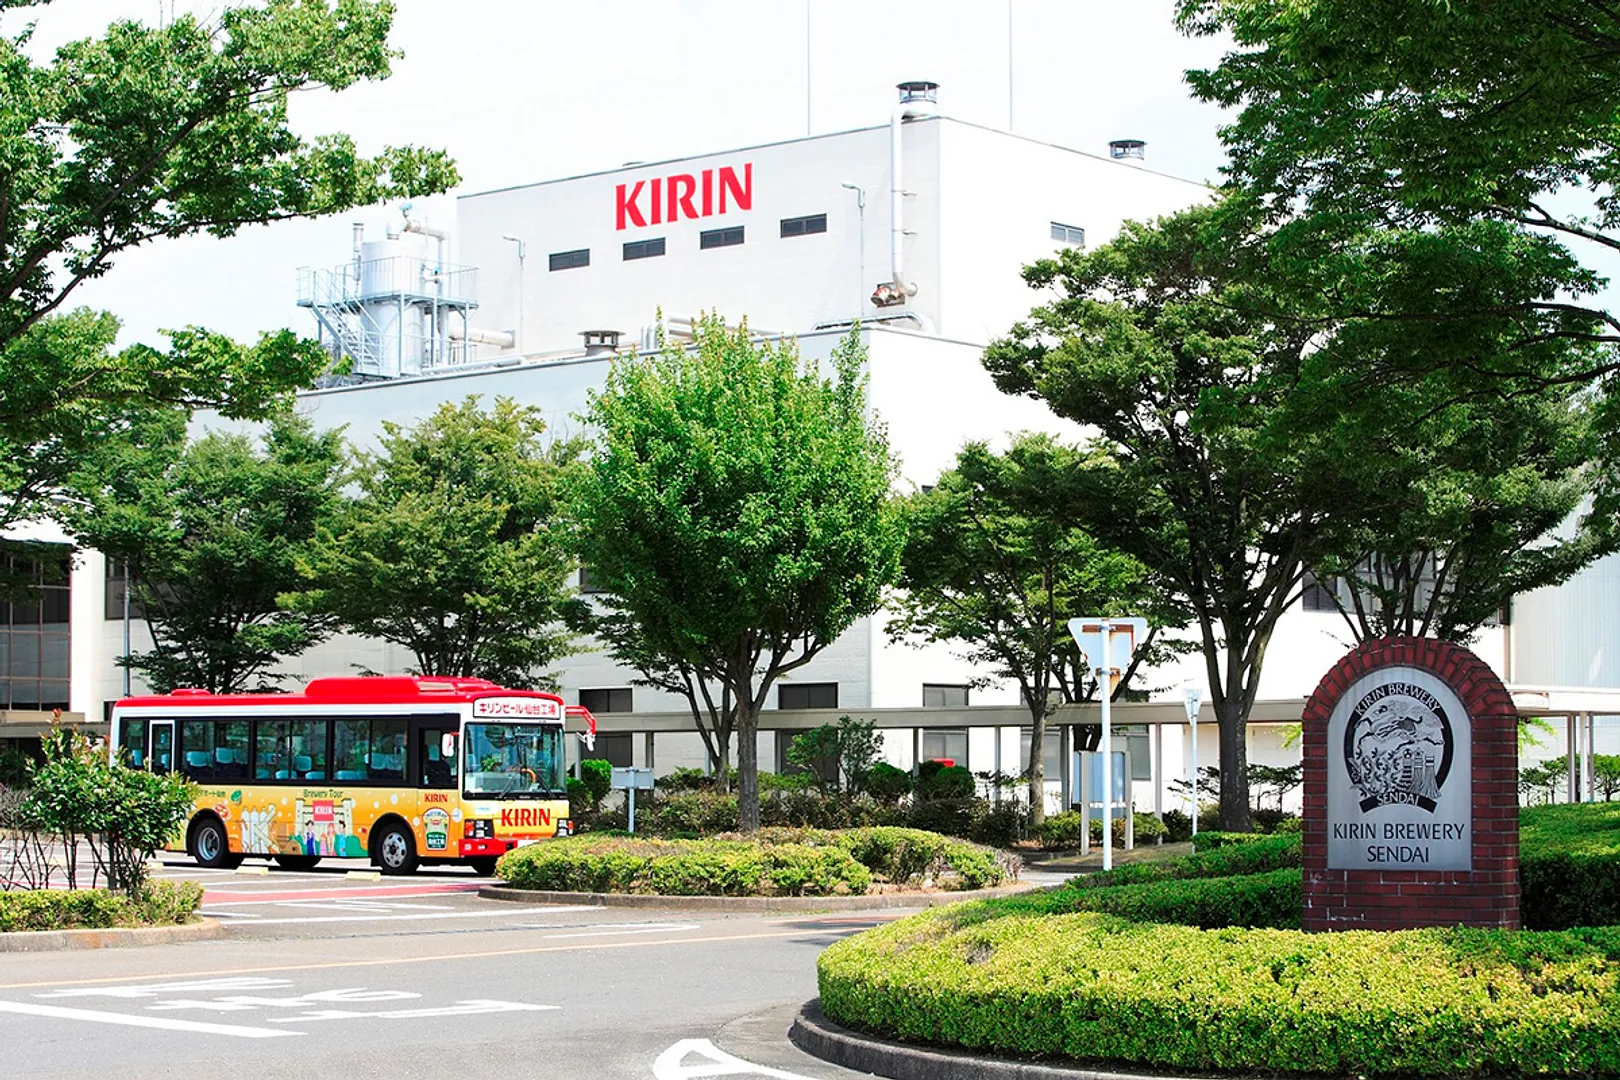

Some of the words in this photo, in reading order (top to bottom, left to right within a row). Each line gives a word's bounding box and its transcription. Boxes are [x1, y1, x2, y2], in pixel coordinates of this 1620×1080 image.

[616, 163, 752, 231] KIRIN
[1355, 686, 1388, 715] KIRIN
[1388, 683, 1441, 711] BREWERY
[479, 702, 556, 716] キリンビール仙台工場
[303, 789, 327, 798] Brewery
[329, 789, 343, 798] Tour
[424, 793, 448, 803] KIRIN
[1376, 791, 1419, 806] SENDAI
[501, 808, 551, 827] KIRIN
[1333, 823, 1377, 840] KIRIN
[1384, 823, 1466, 840] BREWERY
[1367, 846, 1430, 863] SENDAI
